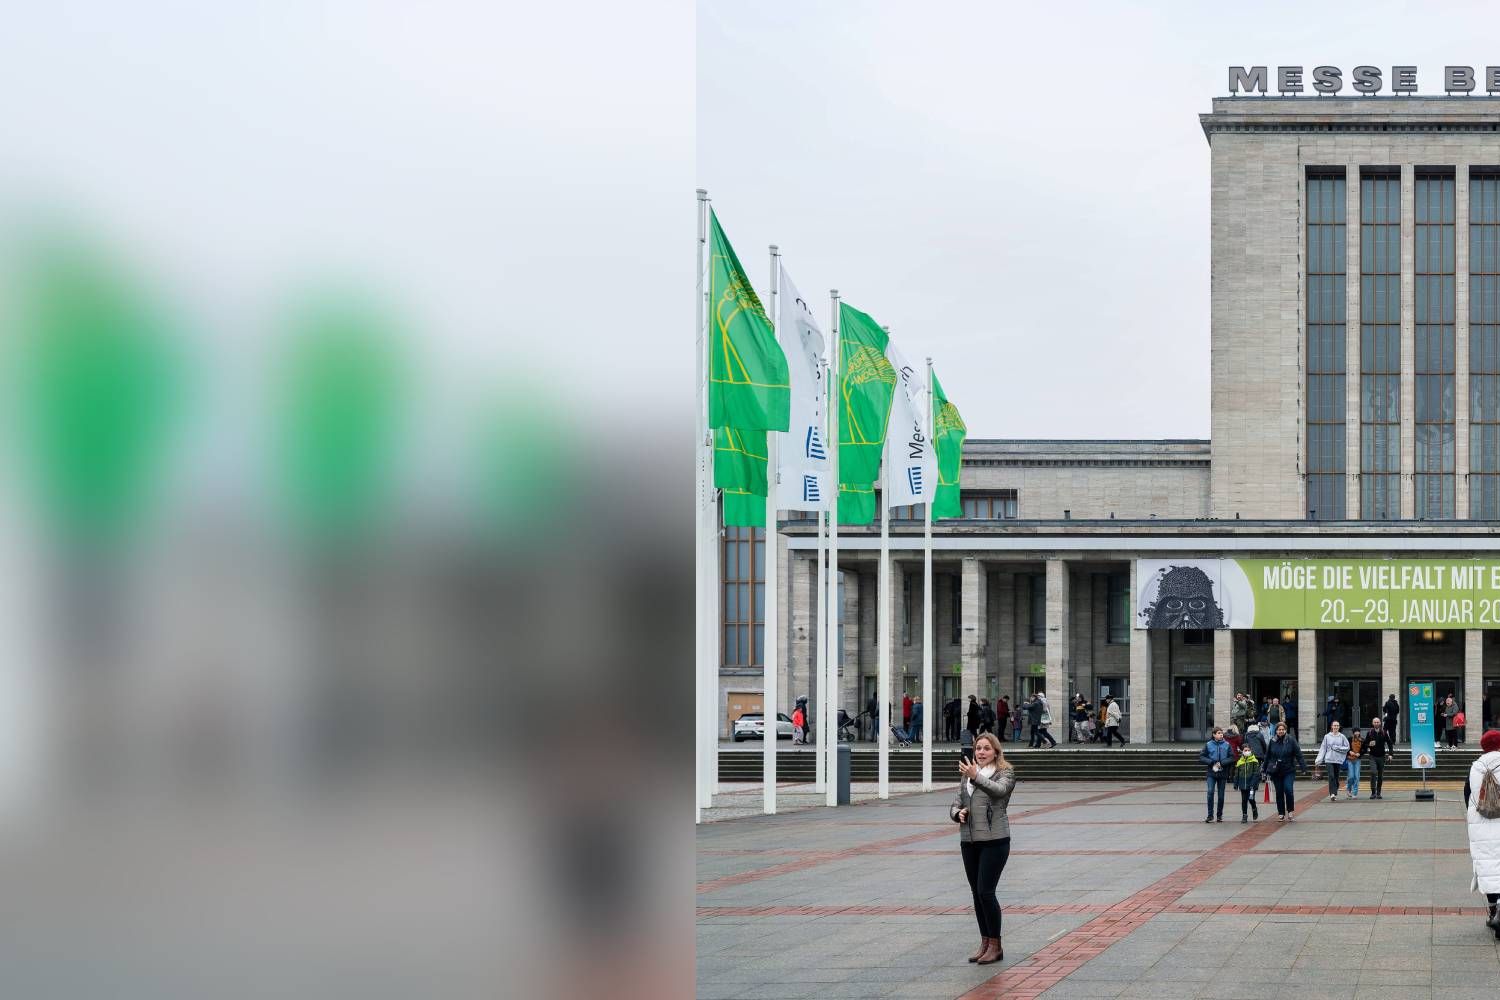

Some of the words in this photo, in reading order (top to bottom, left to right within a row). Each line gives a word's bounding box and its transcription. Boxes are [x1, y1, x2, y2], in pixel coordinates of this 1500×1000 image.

[1229, 66, 1418, 92] MESSE
[1263, 562, 1317, 590] MÖGE
[1323, 566, 1353, 590] DIE
[1358, 566, 1446, 590] VIELFALT
[1451, 566, 1486, 590] MIT
[1399, 599, 1474, 623] JANUAR
